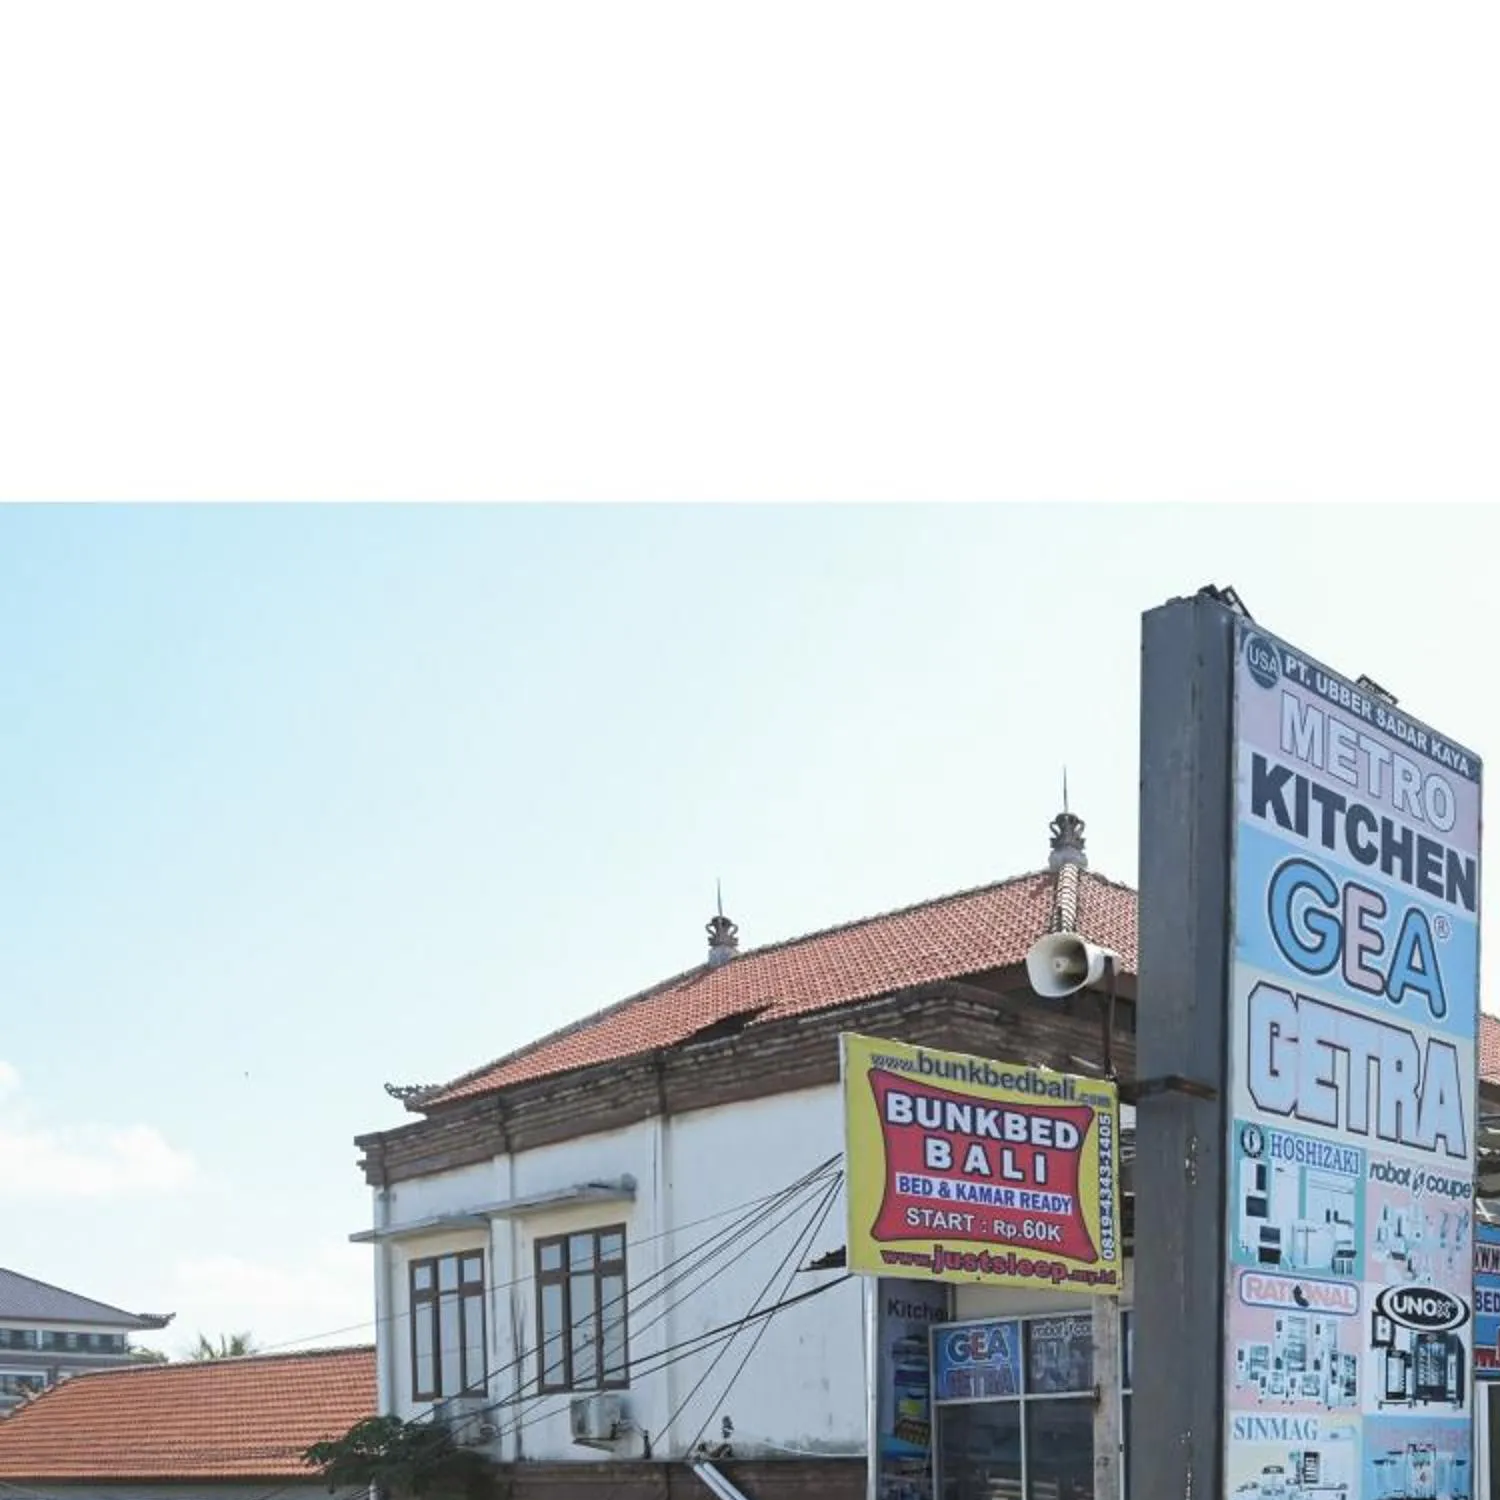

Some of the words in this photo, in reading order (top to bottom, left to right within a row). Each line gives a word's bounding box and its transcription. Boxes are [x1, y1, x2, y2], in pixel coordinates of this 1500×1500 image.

[1249, 644, 1277, 673] USA
[1285, 655, 1311, 686] PT.
[1316, 671, 1373, 720] UBBER
[1377, 707, 1428, 749] SADAR
[1431, 734, 1471, 775] KAYA
[1281, 690, 1457, 833] METRO
[1251, 752, 1476, 912] KITCHEN
[1268, 857, 1447, 1018] GEA
[1248, 981, 1466, 1158] GETRA
[886, 1092, 1080, 1149] BUNKBED
[924, 1136, 1047, 1184] BALI
[1270, 1133, 1359, 1175] HOSHIZAKI
[899, 1175, 934, 1196] BED
[938, 1181, 953, 1198] &
[955, 1185, 1015, 1207] KAMAR
[1020, 1193, 1071, 1213] READY
[1370, 1160, 1410, 1187] robot
[1426, 1175, 1471, 1200] coupe
[906, 1208, 975, 1232] START
[993, 1219, 1062, 1242] Rp.60K
[1246, 1275, 1350, 1309] RATONAL
[1391, 1296, 1451, 1319] UNOX
[948, 1329, 1009, 1362] GEA
[1233, 1417, 1318, 1440] SINMAG
